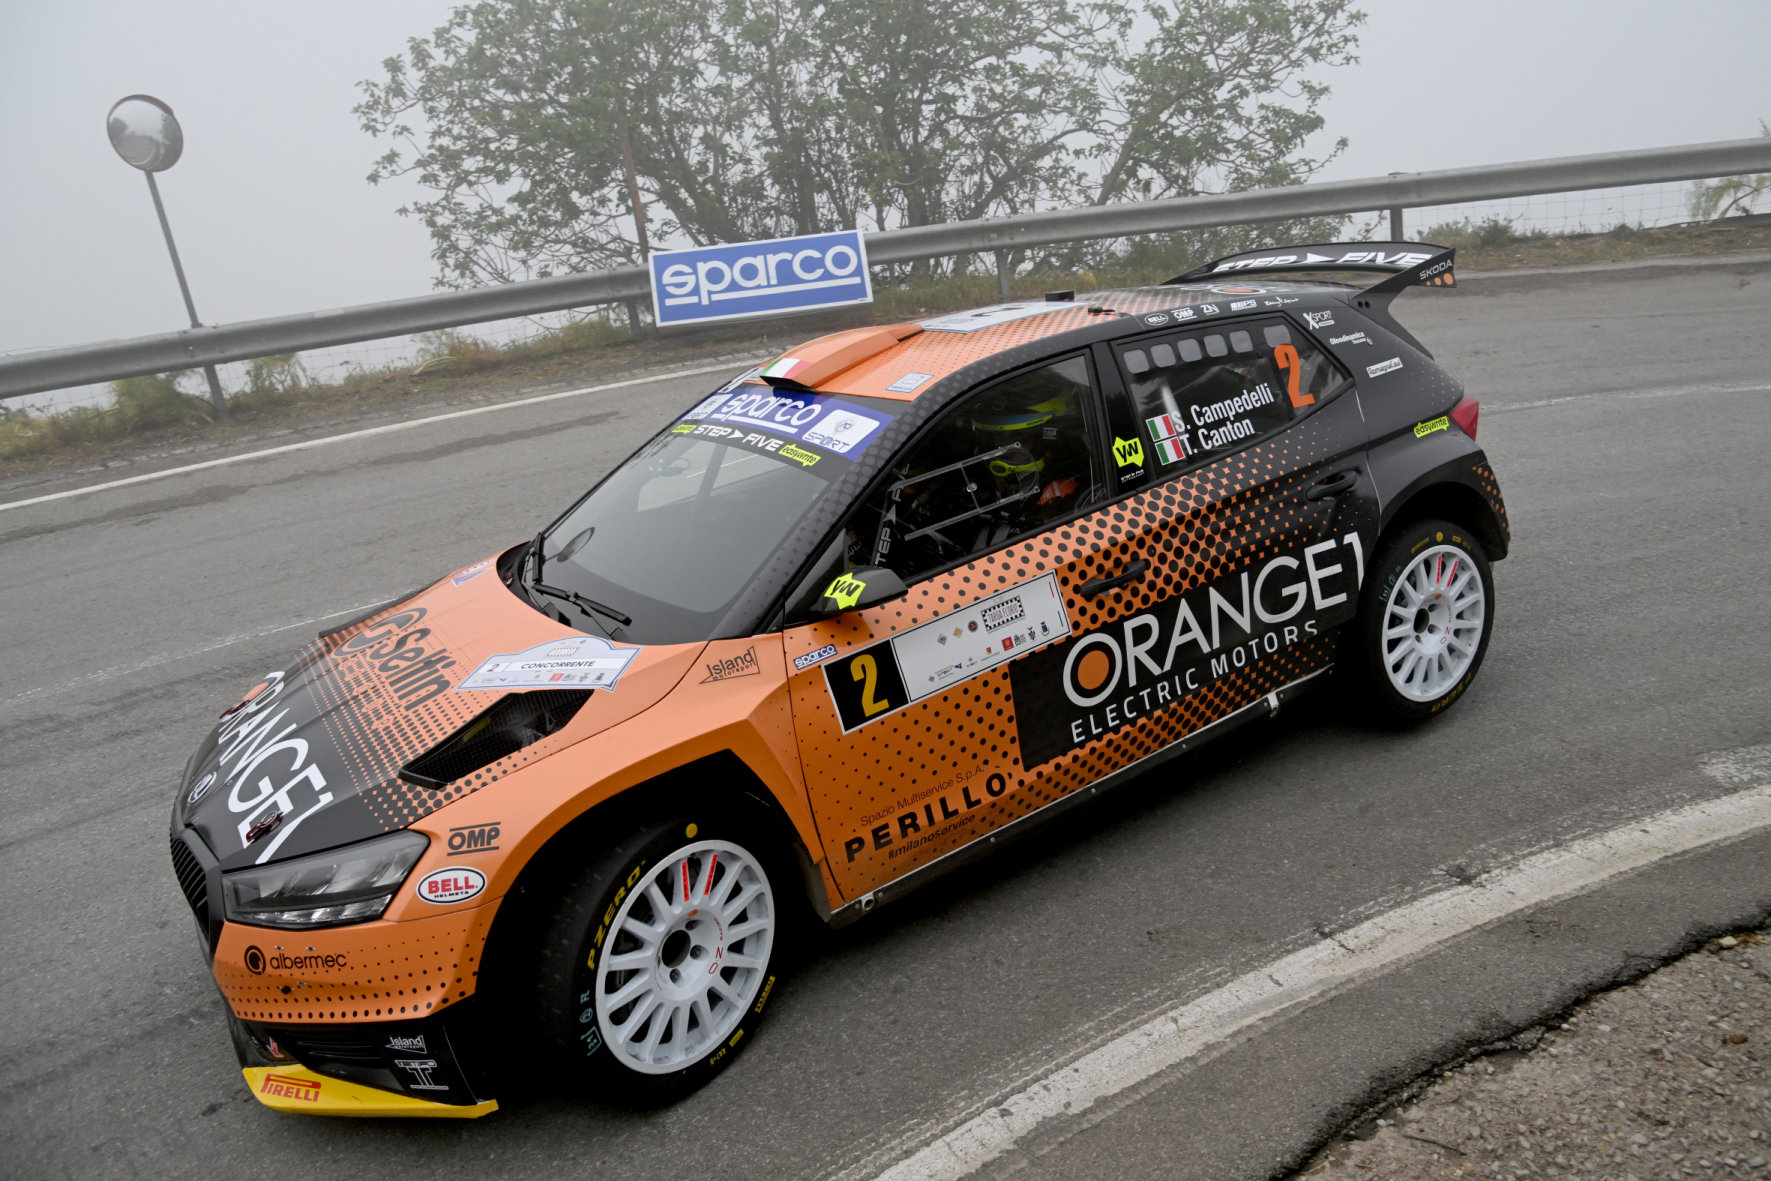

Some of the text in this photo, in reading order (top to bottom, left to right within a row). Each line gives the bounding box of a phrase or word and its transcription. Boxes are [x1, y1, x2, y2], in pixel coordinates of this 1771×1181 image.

[1335, 252, 1432, 268] FIVE
[662, 245, 858, 305] sparco
[1174, 309, 1194, 319] OMP
[1274, 343, 1316, 408] 2
[721, 394, 822, 426] sparco
[1171, 382, 1275, 433] S. Campedelli
[693, 424, 732, 438] STEP
[742, 433, 785, 451] FIVE
[804, 432, 851, 451] SPORT
[1179, 419, 1256, 456] T. Canton
[874, 527, 892, 568] TEP
[1062, 532, 1365, 708] ORANGE1
[521, 660, 596, 670] CONCORRENTE
[707, 648, 755, 677] Island
[713, 662, 757, 681] motorsport
[795, 645, 836, 669] sparco
[850, 654, 890, 718] 2
[1071, 619, 1319, 744] ELECTRIC MOTORS
[844, 772, 1007, 864] PERILLO
[860, 805, 896, 828] Spazio
[897, 780, 954, 810] Multiservice
[448, 826, 501, 851] OMP
[888, 814, 976, 860] #milanoservice
[428, 876, 475, 894] BELL
[434, 890, 470, 899] HELMETS
[270, 953, 347, 970] albermec
[390, 1035, 423, 1046] Island
[260, 1073, 322, 1103] PIRELLI
